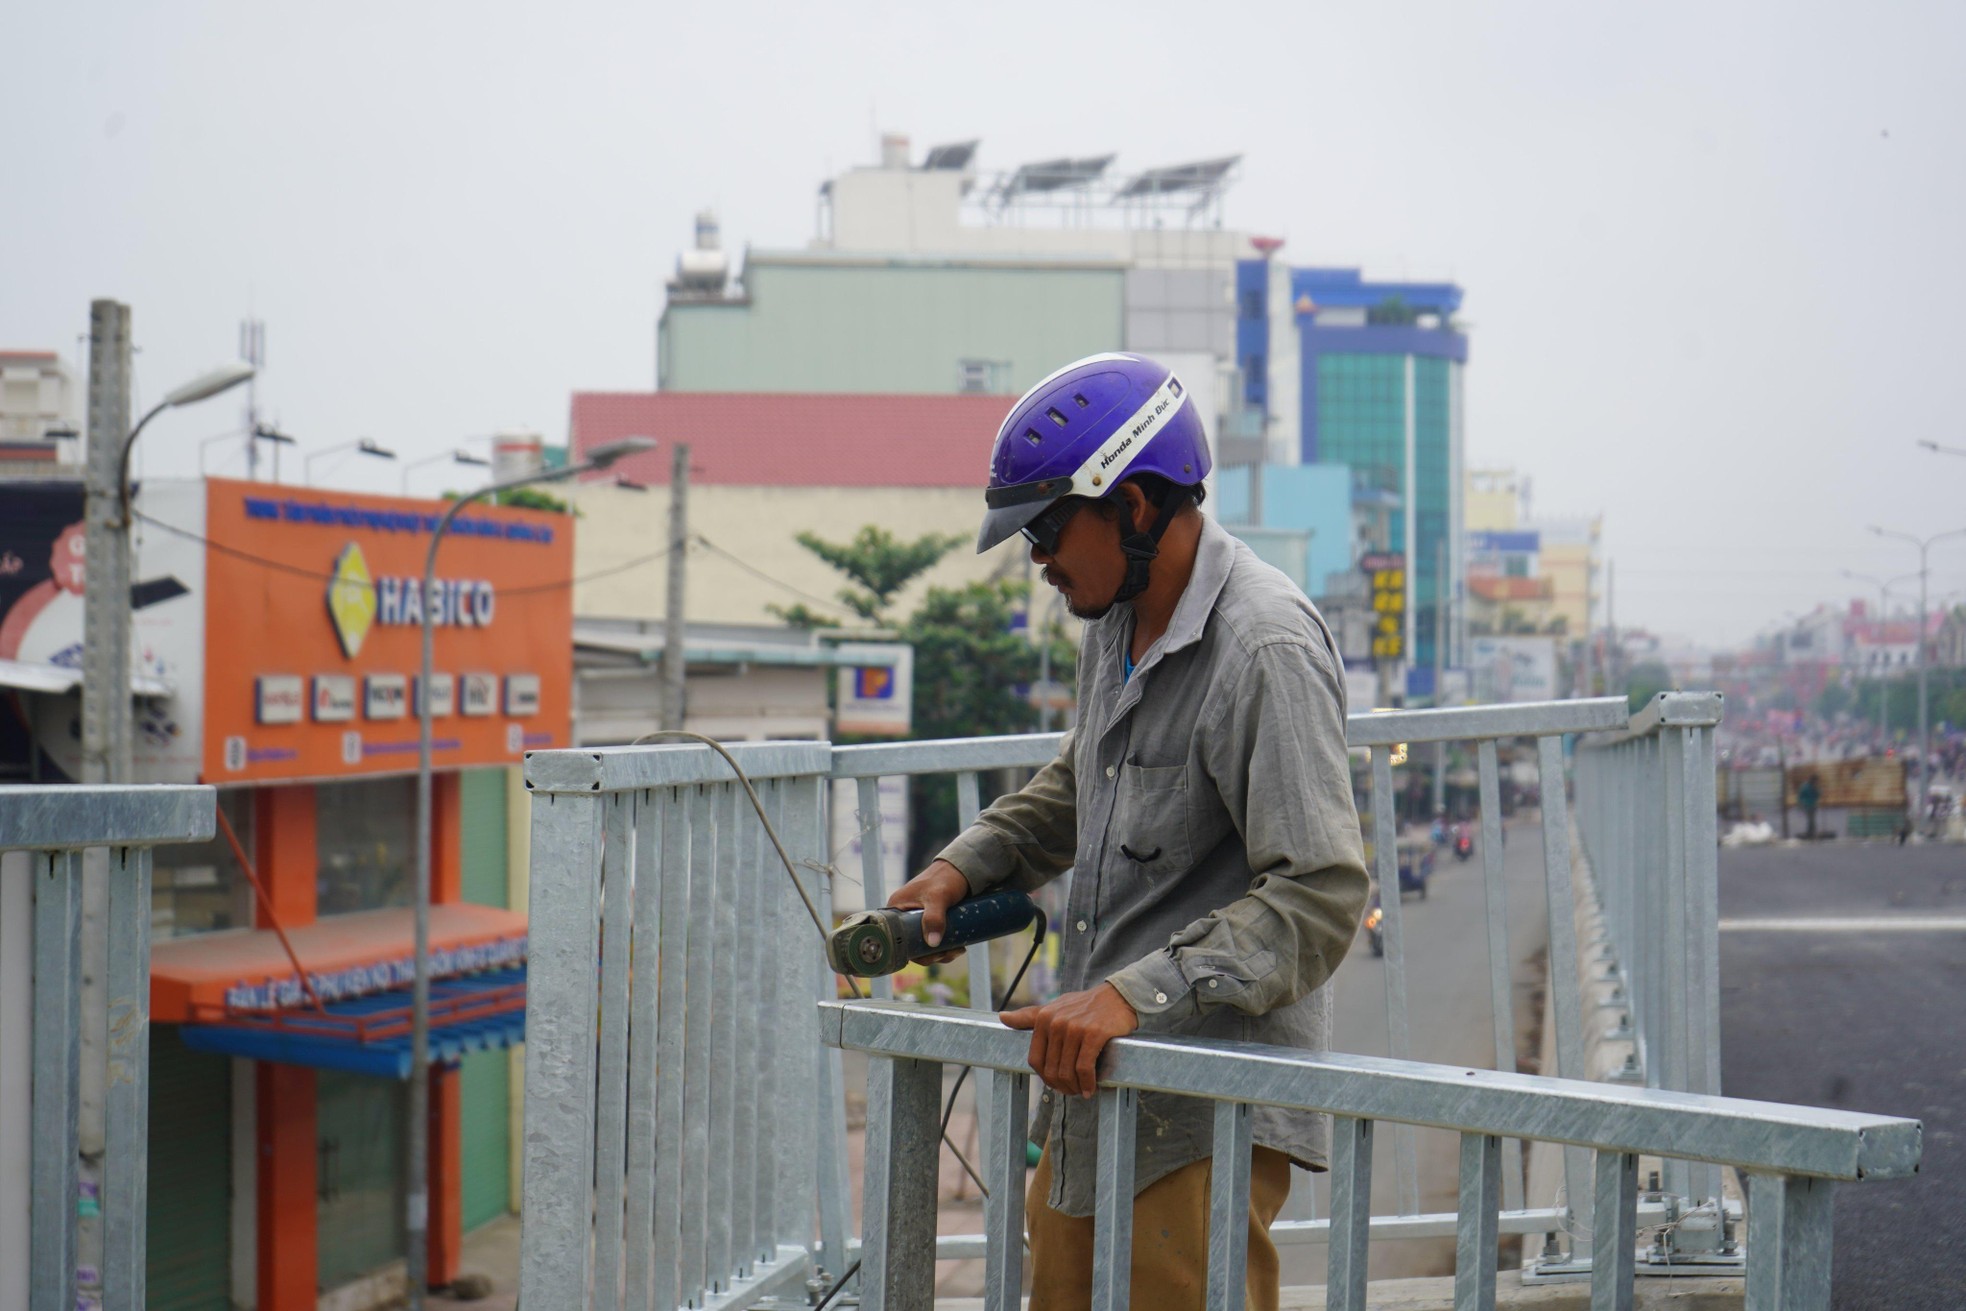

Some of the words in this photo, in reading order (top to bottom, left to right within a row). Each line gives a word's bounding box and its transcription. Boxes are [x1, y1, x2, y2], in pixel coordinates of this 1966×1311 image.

[1100, 437, 1132, 469] Honda
[1132, 414, 1155, 438] Minh
[379, 576, 495, 626] HABICO
